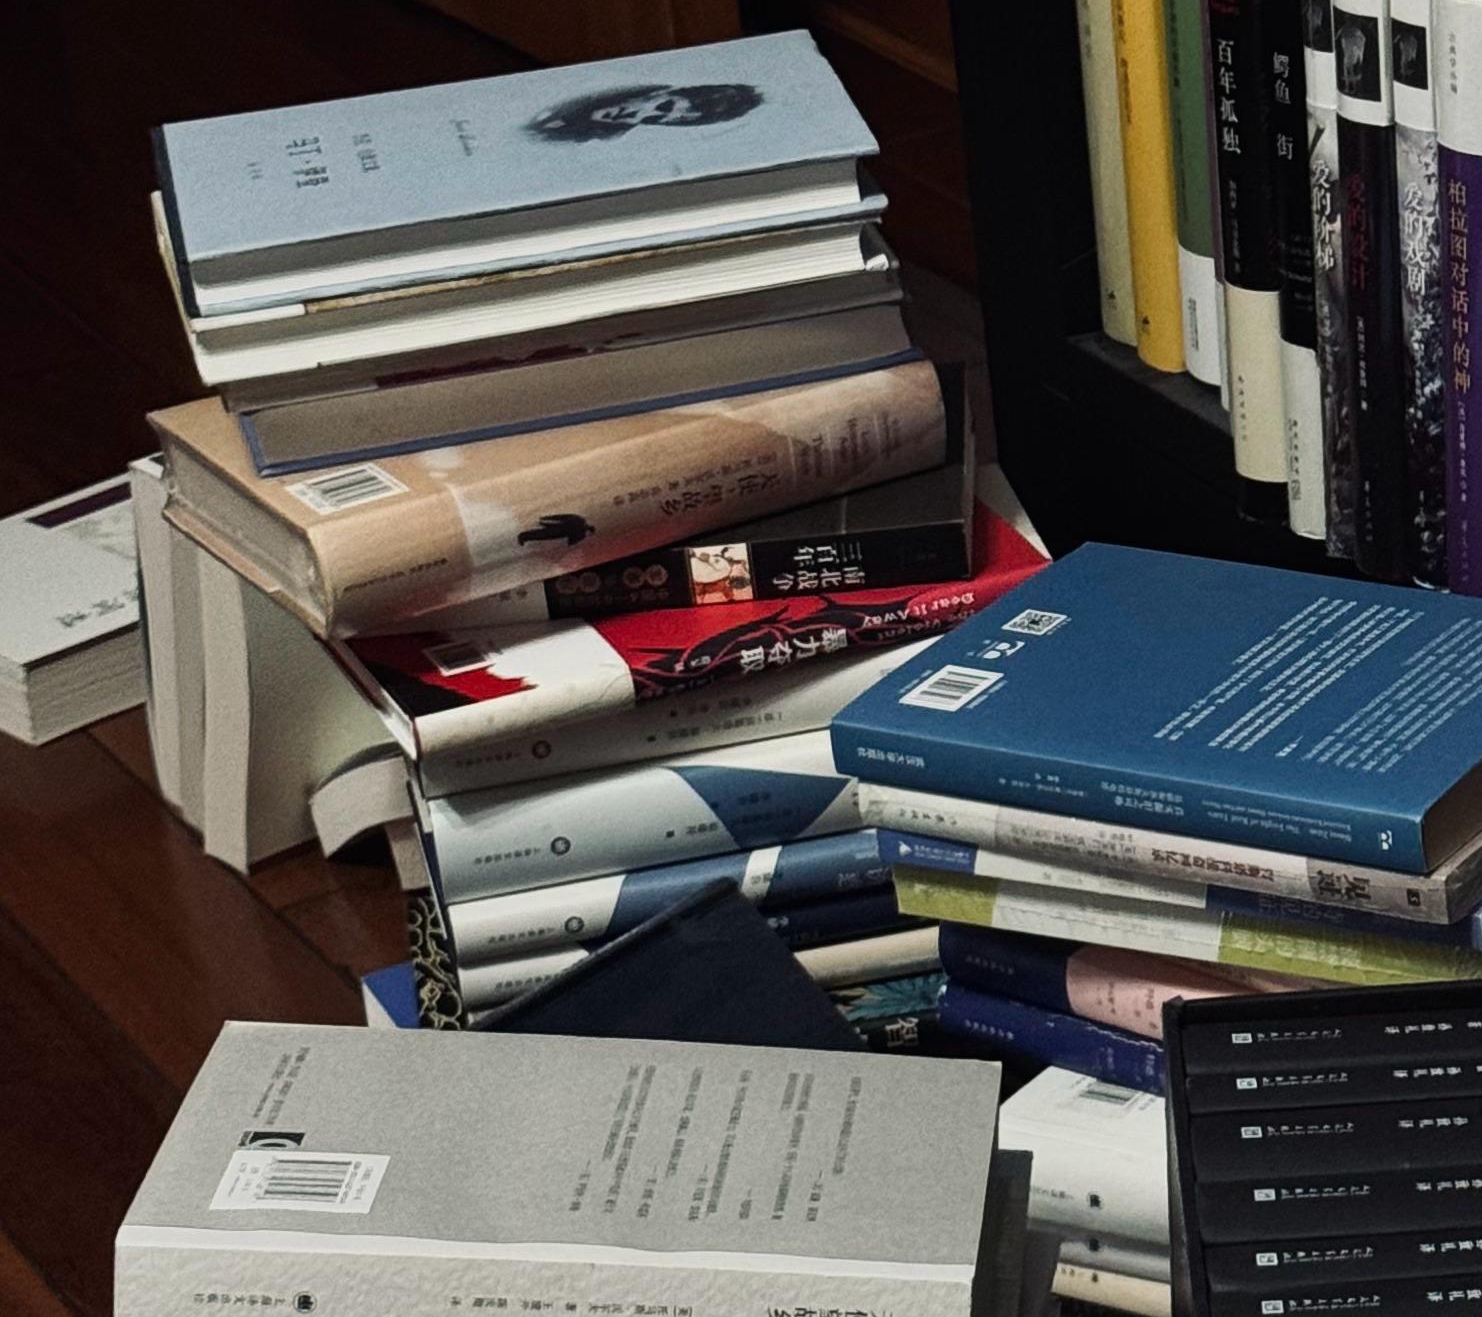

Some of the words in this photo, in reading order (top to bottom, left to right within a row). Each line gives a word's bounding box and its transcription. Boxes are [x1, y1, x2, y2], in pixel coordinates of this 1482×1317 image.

[1216, 37, 1242, 156] 百年孤独
[1448, 179, 1471, 394] 柏拉图对话中的神
[772, 565, 867, 592] 南北战争
[861, 607, 911, 629] Away
[739, 627, 849, 676] 暴力夺取
